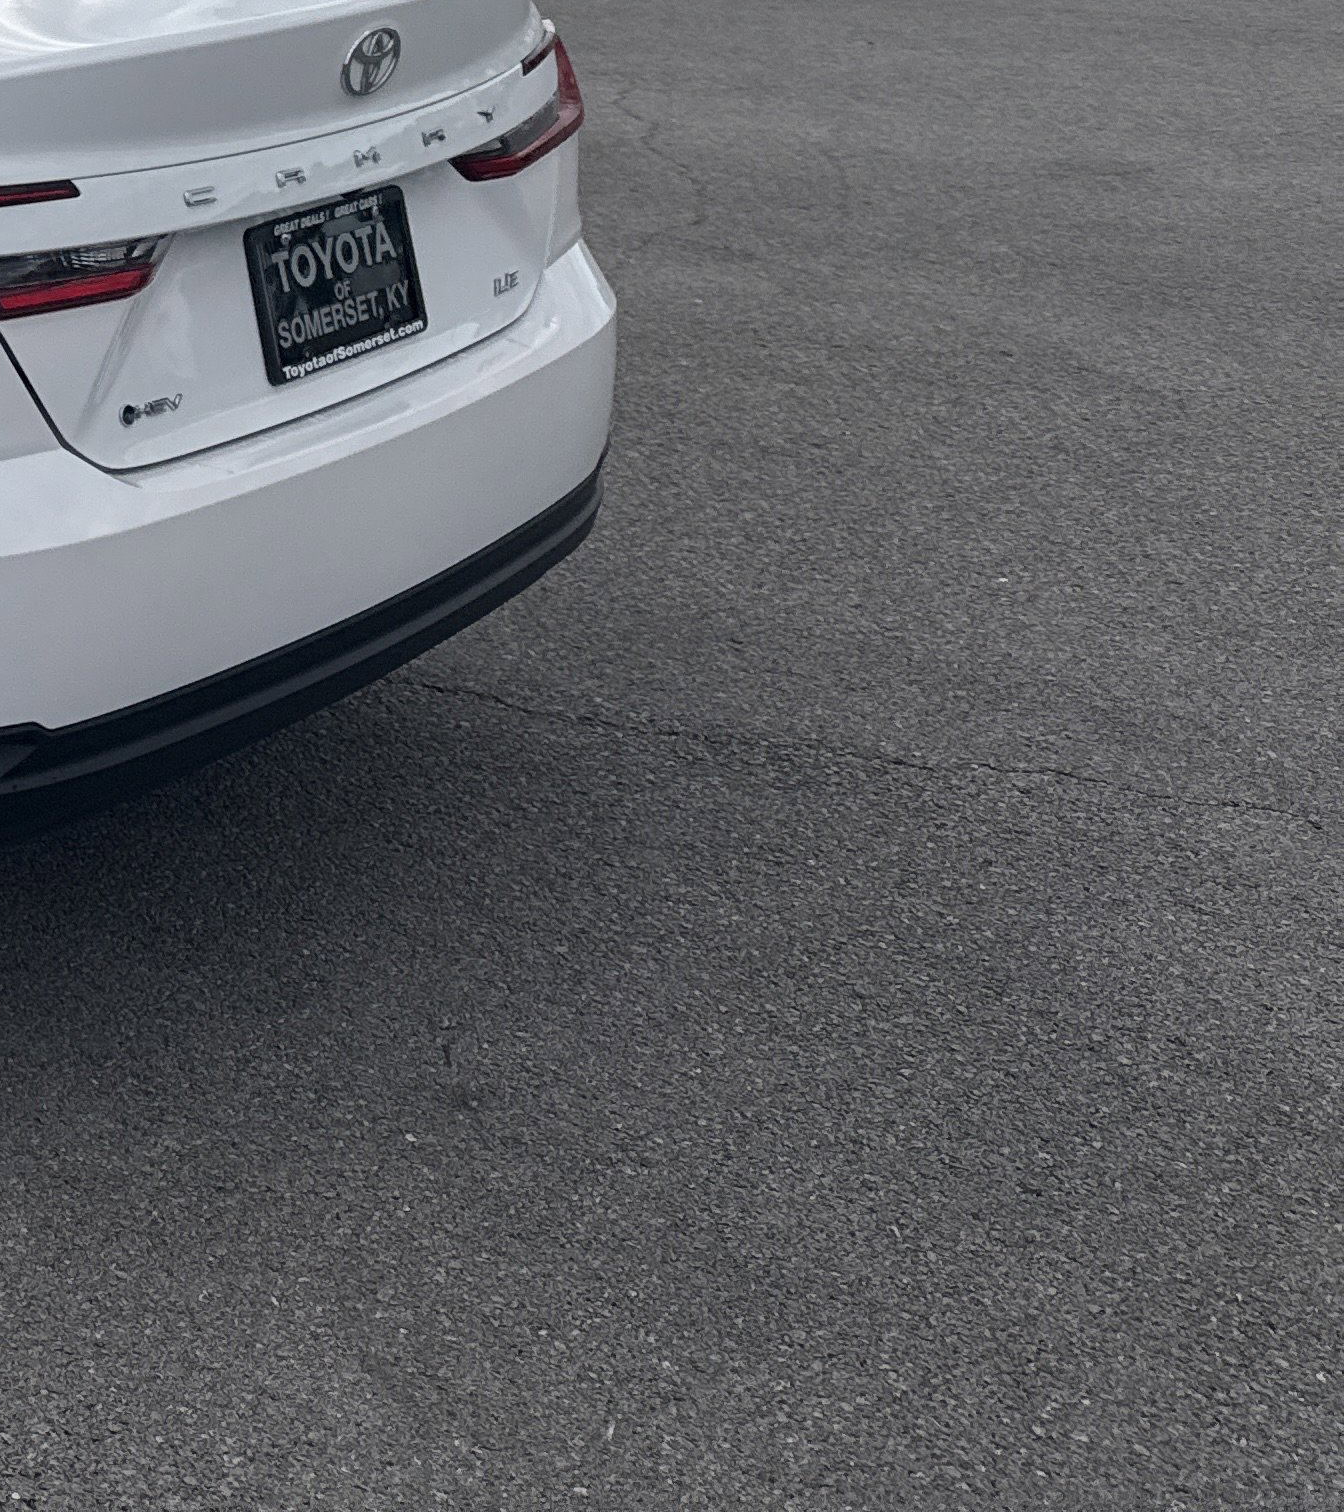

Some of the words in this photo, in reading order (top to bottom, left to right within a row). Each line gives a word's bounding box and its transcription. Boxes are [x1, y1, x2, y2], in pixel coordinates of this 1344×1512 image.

[183, 105, 497, 207] CAMRY
[271, 222, 397, 293] TOYOTA
[334, 280, 351, 300] OF
[278, 291, 384, 349] SOMERSET,
[386, 280, 410, 311] KY
[282, 319, 424, 379] ToyotaofSomerset.com
